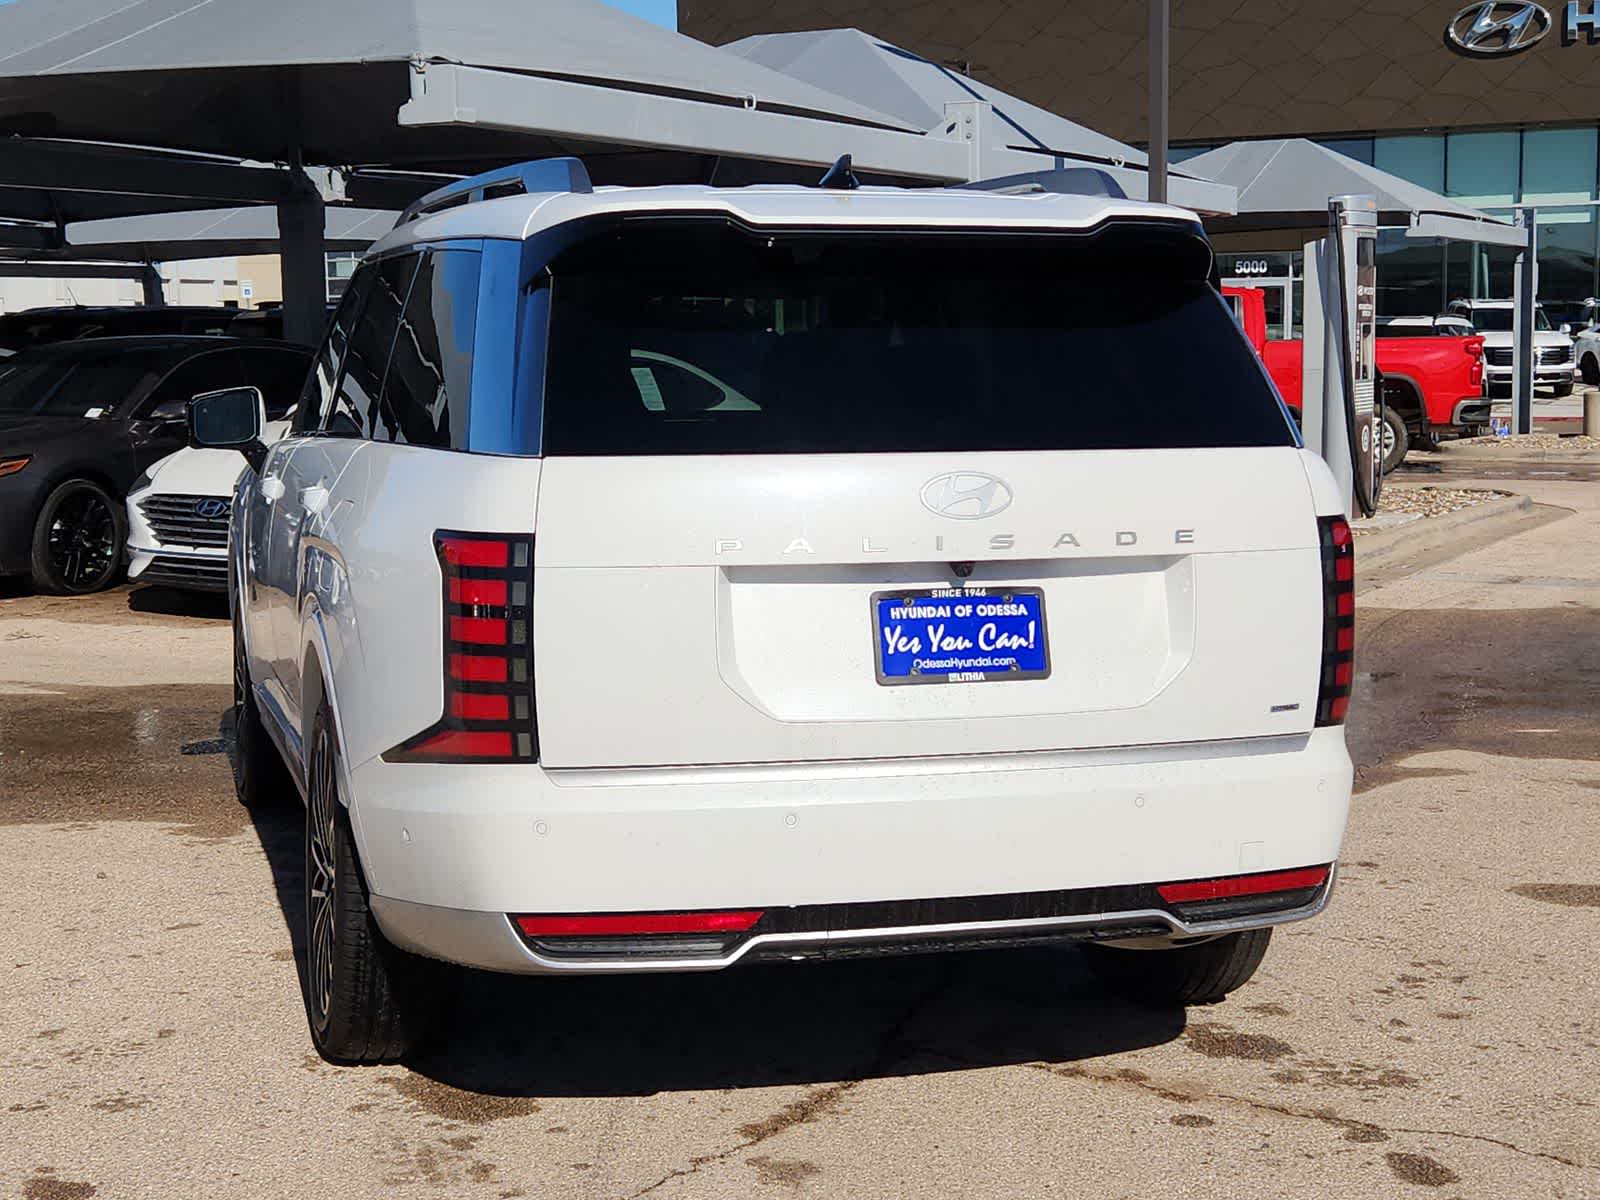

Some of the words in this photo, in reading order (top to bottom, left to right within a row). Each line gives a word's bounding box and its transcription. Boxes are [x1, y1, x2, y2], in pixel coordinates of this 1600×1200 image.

[1235, 260, 1268, 274] 5000
[714, 528, 1196, 555] PALISADE
[931, 589, 962, 598] SINCE
[964, 588, 987, 597] 1946
[890, 606, 951, 620] HYUNDAI
[954, 605, 973, 617] OF
[976, 603, 1028, 617] ODESSA
[884, 625, 922, 655] Yes
[927, 624, 973, 653] You
[978, 620, 1036, 651] Can!
[913, 656, 1017, 671] OdessaHyundai.com
